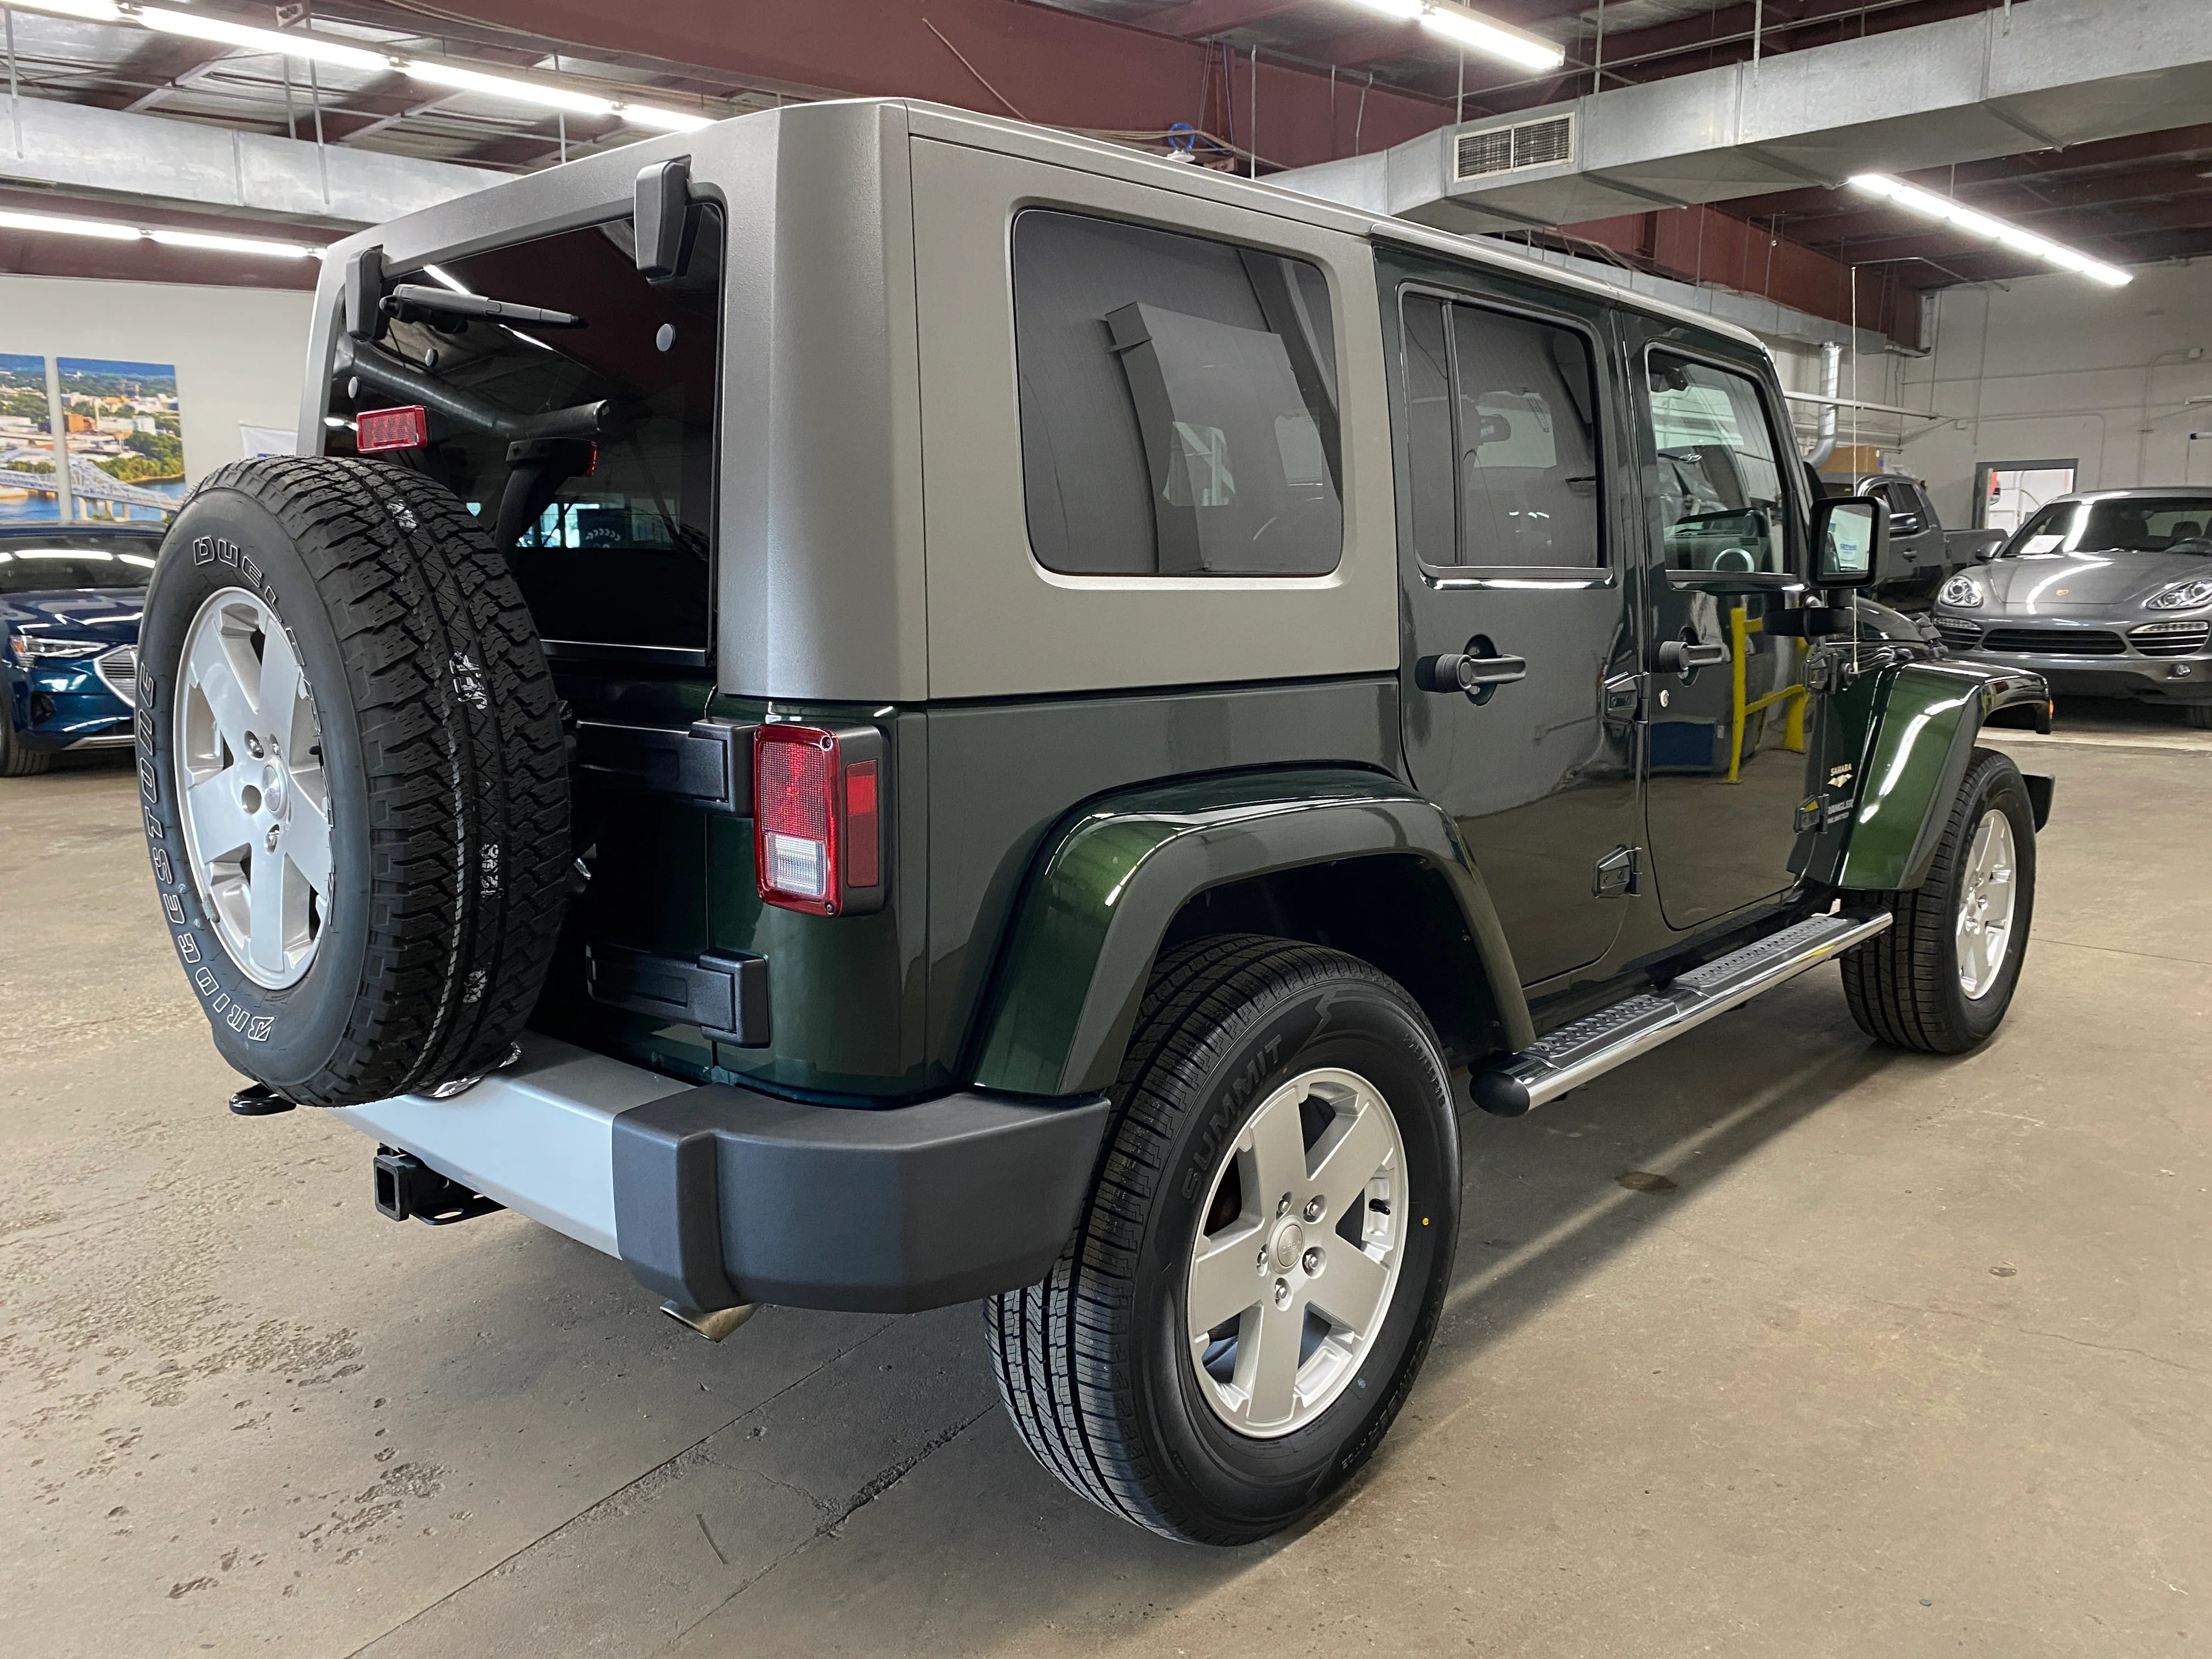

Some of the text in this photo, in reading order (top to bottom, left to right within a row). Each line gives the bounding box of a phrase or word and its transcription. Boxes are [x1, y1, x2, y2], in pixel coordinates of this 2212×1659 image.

[139, 661, 275, 1042] BRIDGESTONE
[1830, 763, 1853, 776] SAHARA
[1182, 1034, 1283, 1204] SUMMIT
